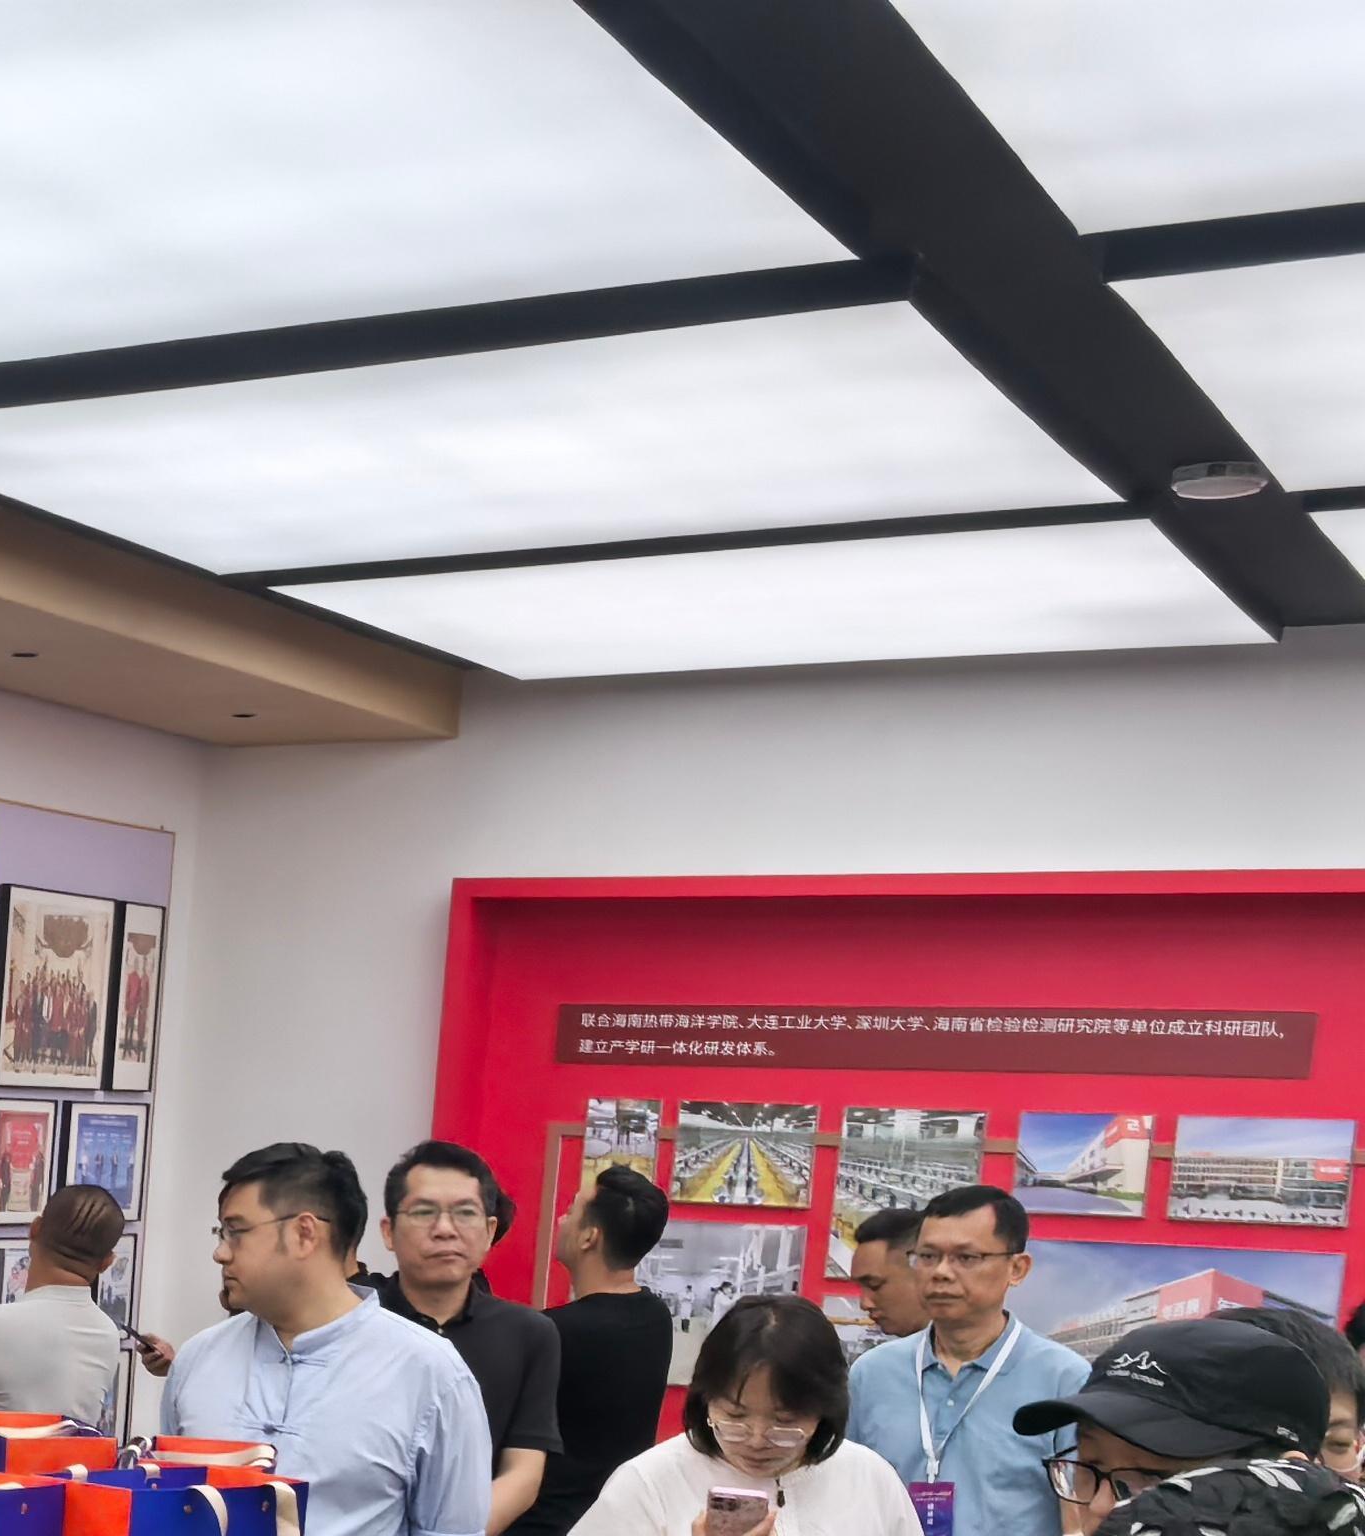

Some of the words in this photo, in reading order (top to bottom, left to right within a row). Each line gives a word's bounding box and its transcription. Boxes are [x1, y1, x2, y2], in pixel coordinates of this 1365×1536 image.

[577, 1038, 777, 1058] 建立产学研一体化研发体系。
